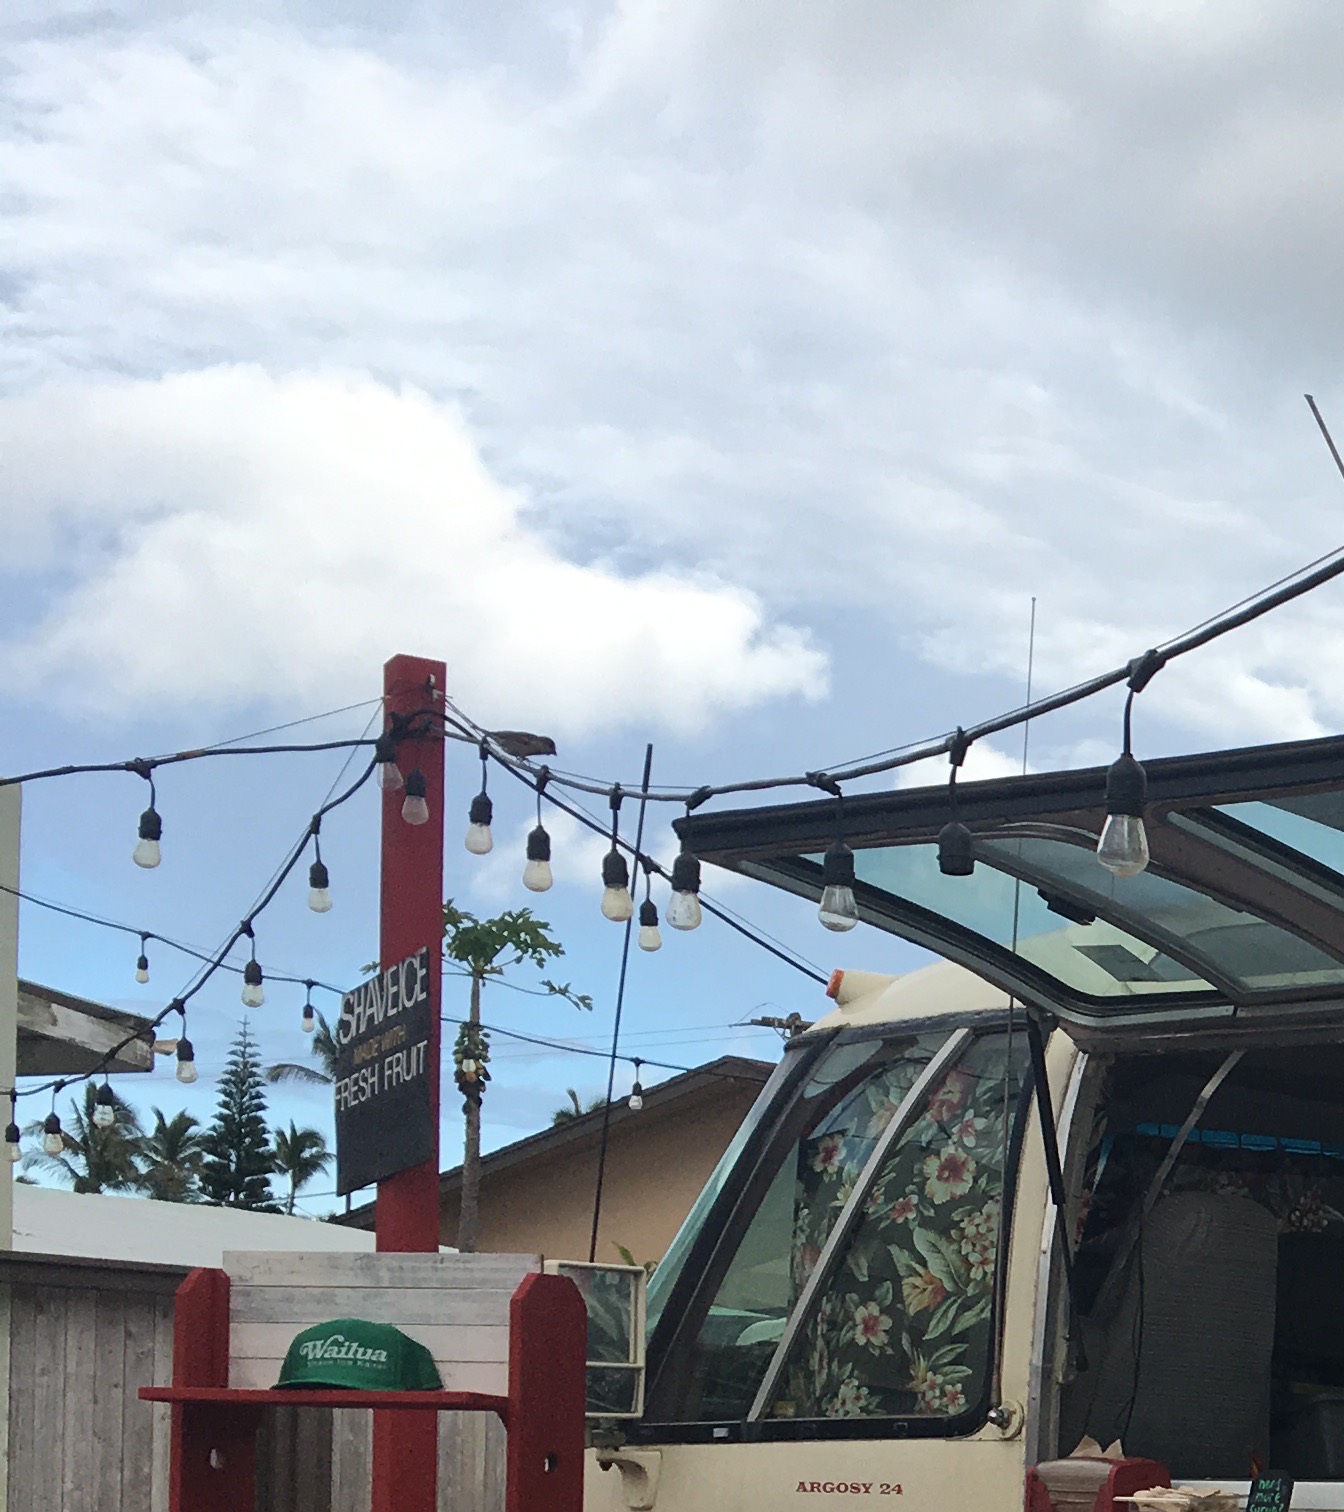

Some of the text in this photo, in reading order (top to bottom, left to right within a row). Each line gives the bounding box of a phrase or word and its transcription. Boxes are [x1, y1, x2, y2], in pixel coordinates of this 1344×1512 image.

[381, 1024, 407, 1053] WITH
[335, 1040, 428, 1111] FRESH FRUIT
[300, 1335, 388, 1362] Wailua
[796, 1481, 904, 1496] ARGOSY 24
